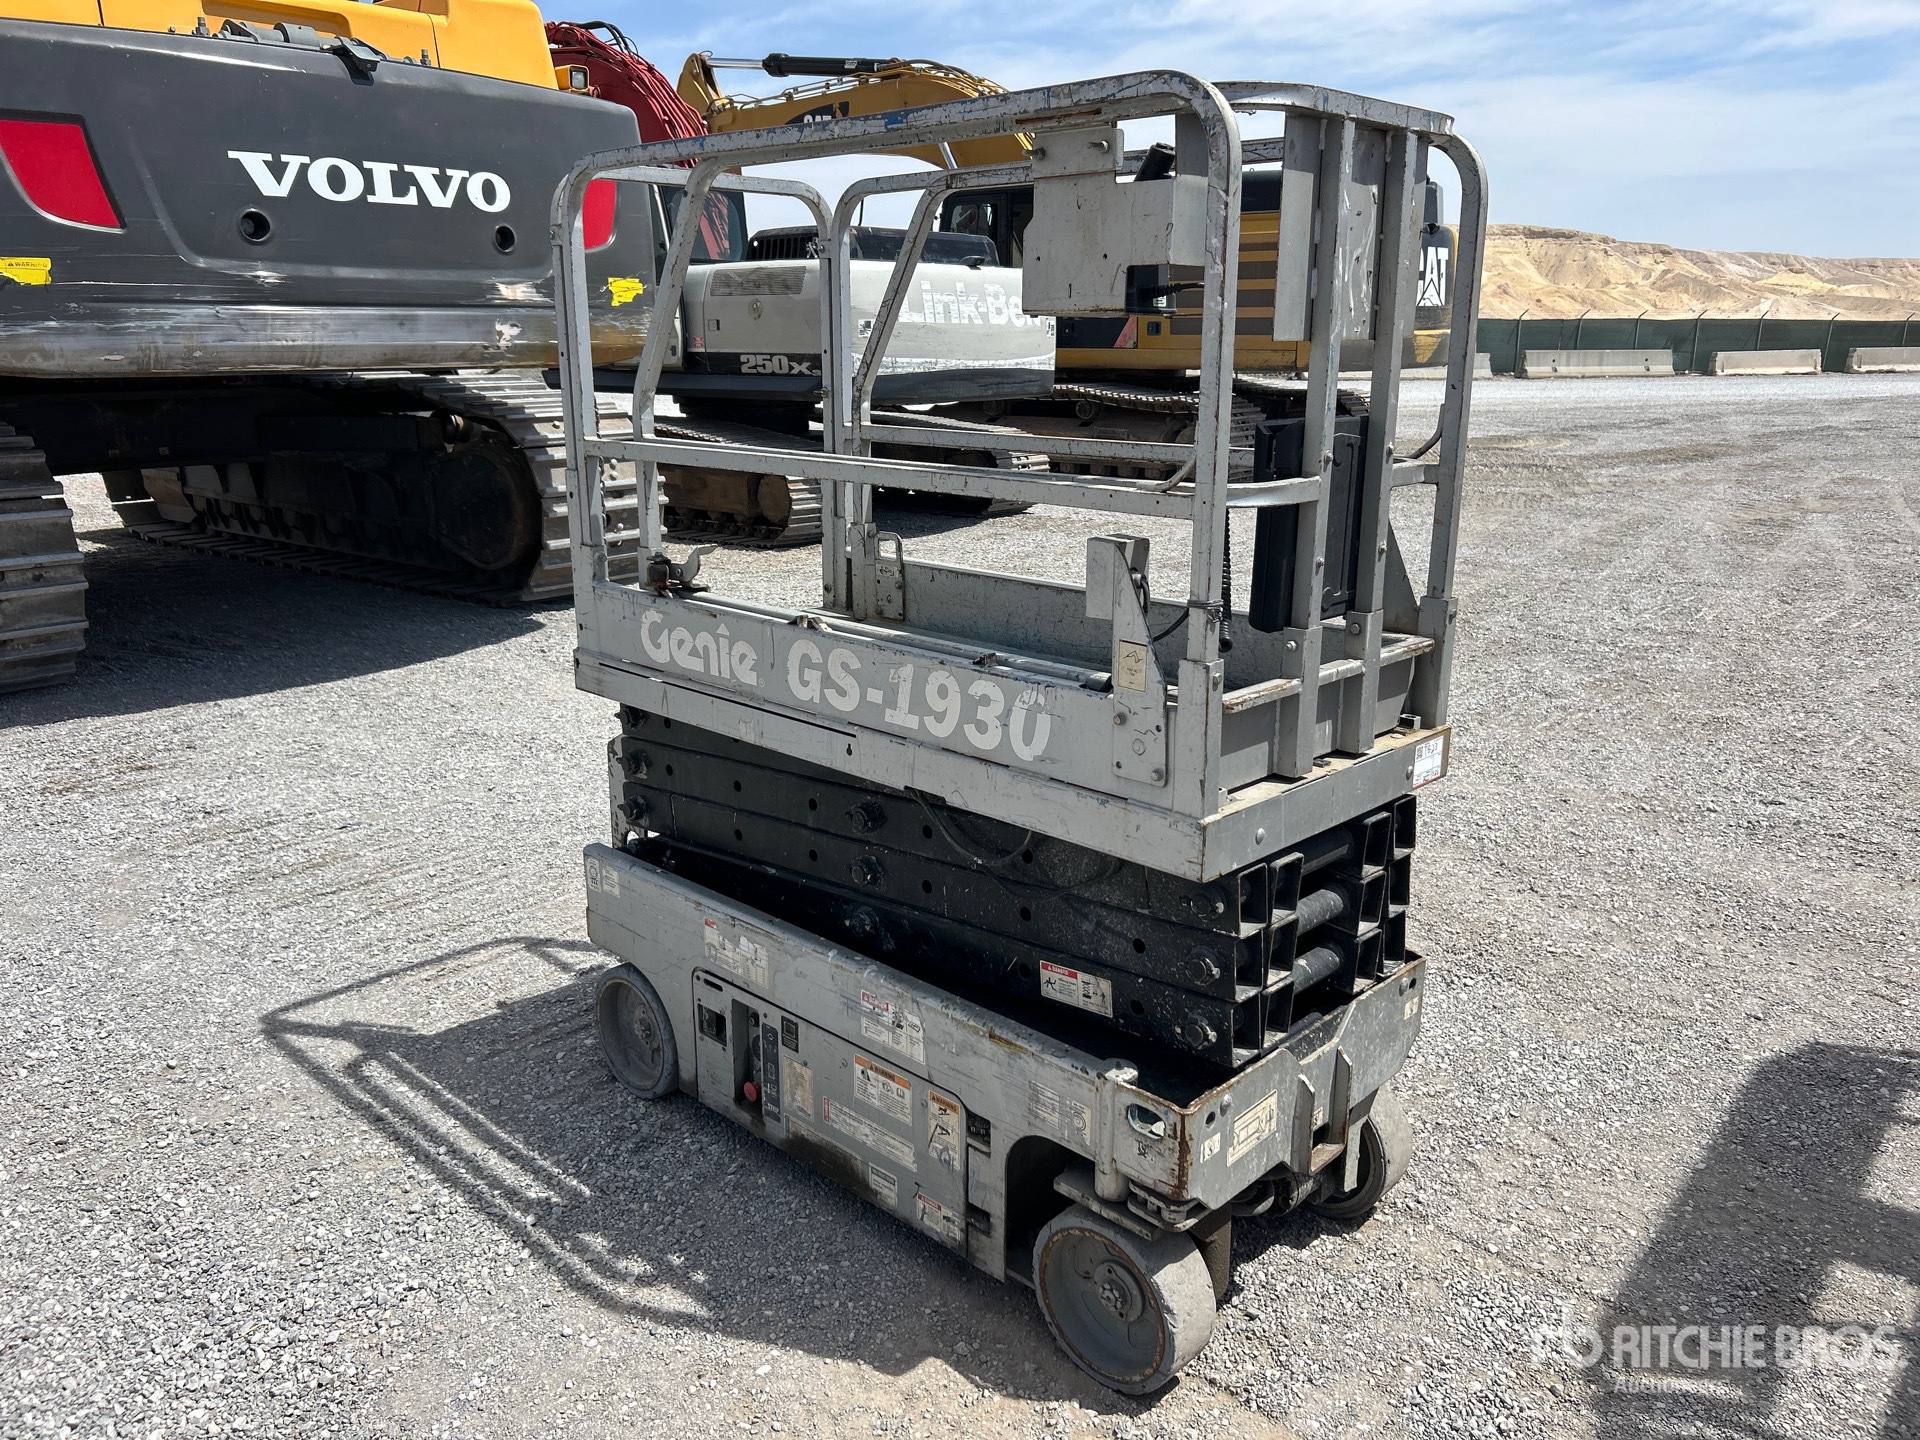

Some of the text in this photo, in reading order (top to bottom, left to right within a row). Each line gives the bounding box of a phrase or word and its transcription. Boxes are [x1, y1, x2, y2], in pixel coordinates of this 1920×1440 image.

[227, 150, 511, 213] VOLVO
[898, 280, 1042, 328] Link-Be
[640, 609, 1051, 762] Genie GS-1930
